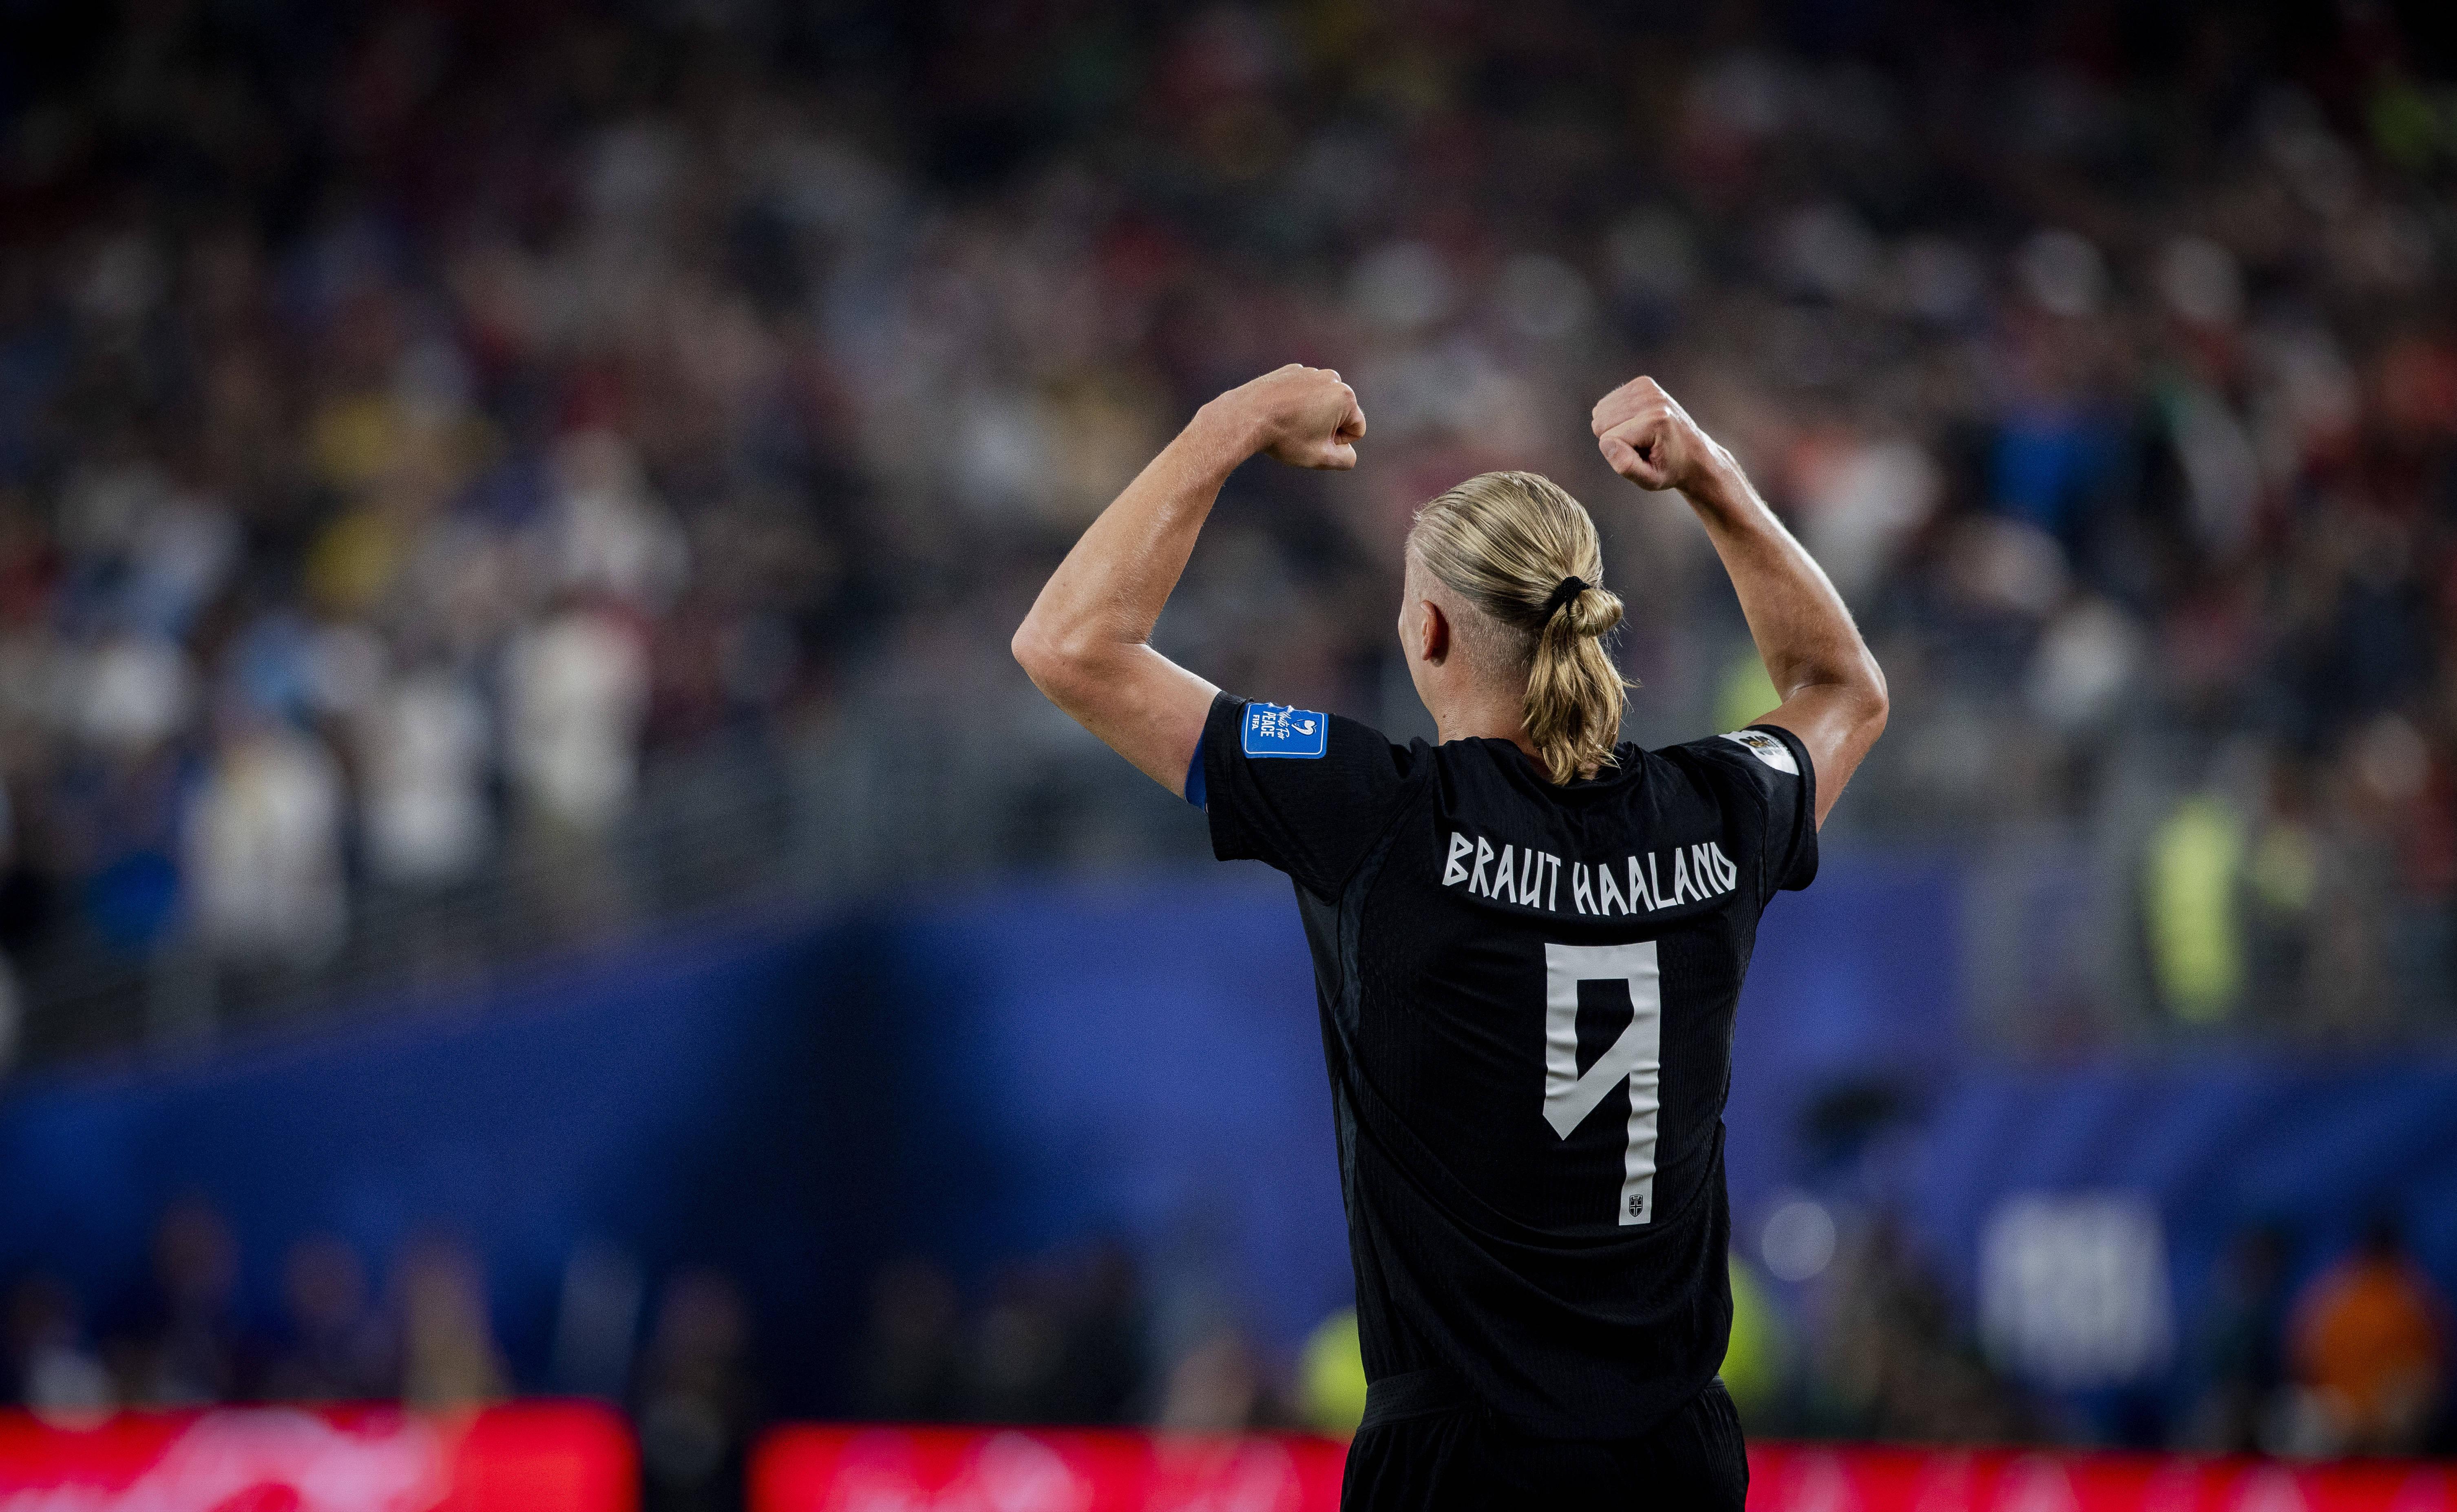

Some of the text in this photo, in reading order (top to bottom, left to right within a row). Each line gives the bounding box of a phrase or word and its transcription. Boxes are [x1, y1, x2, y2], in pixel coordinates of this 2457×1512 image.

[1252, 715, 1260, 730] FIFA
[1260, 711, 1277, 737] PEACE
[1276, 711, 1292, 740] Unite For
[1442, 832, 1737, 916] BRAUT HAALAND
[1543, 940, 1660, 1225] 9
